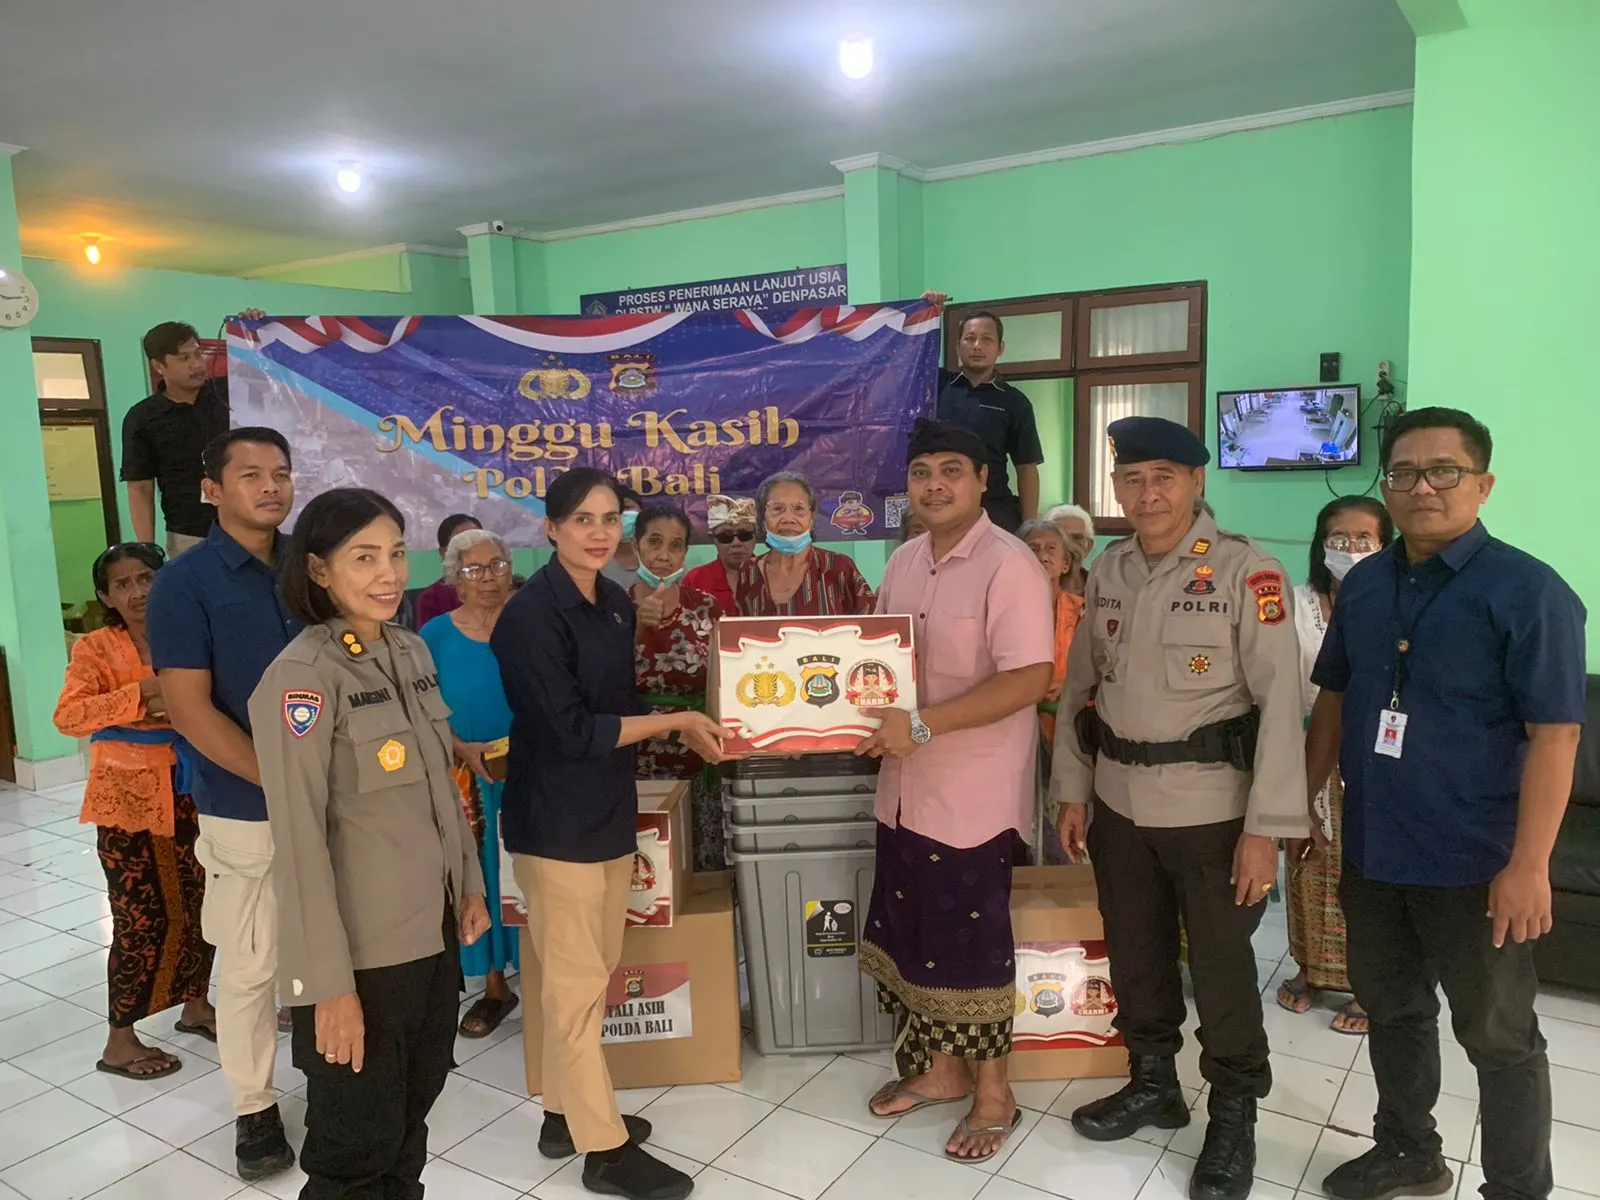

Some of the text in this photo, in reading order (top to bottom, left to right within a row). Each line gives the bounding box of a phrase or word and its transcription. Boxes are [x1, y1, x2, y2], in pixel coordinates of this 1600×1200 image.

[618, 270, 842, 306] PROSES PENERIMAAN LANJUT USIA
[772, 285, 847, 304] DENPASAR
[376, 405, 800, 462] Minggu Kasih
[462, 463, 722, 499] Pol Bali
[1170, 600, 1228, 614] POLRI
[802, 655, 835, 663] BALI
[606, 1000, 666, 1018] TALI ASIH
[601, 1019, 674, 1037] POLDA BALI
